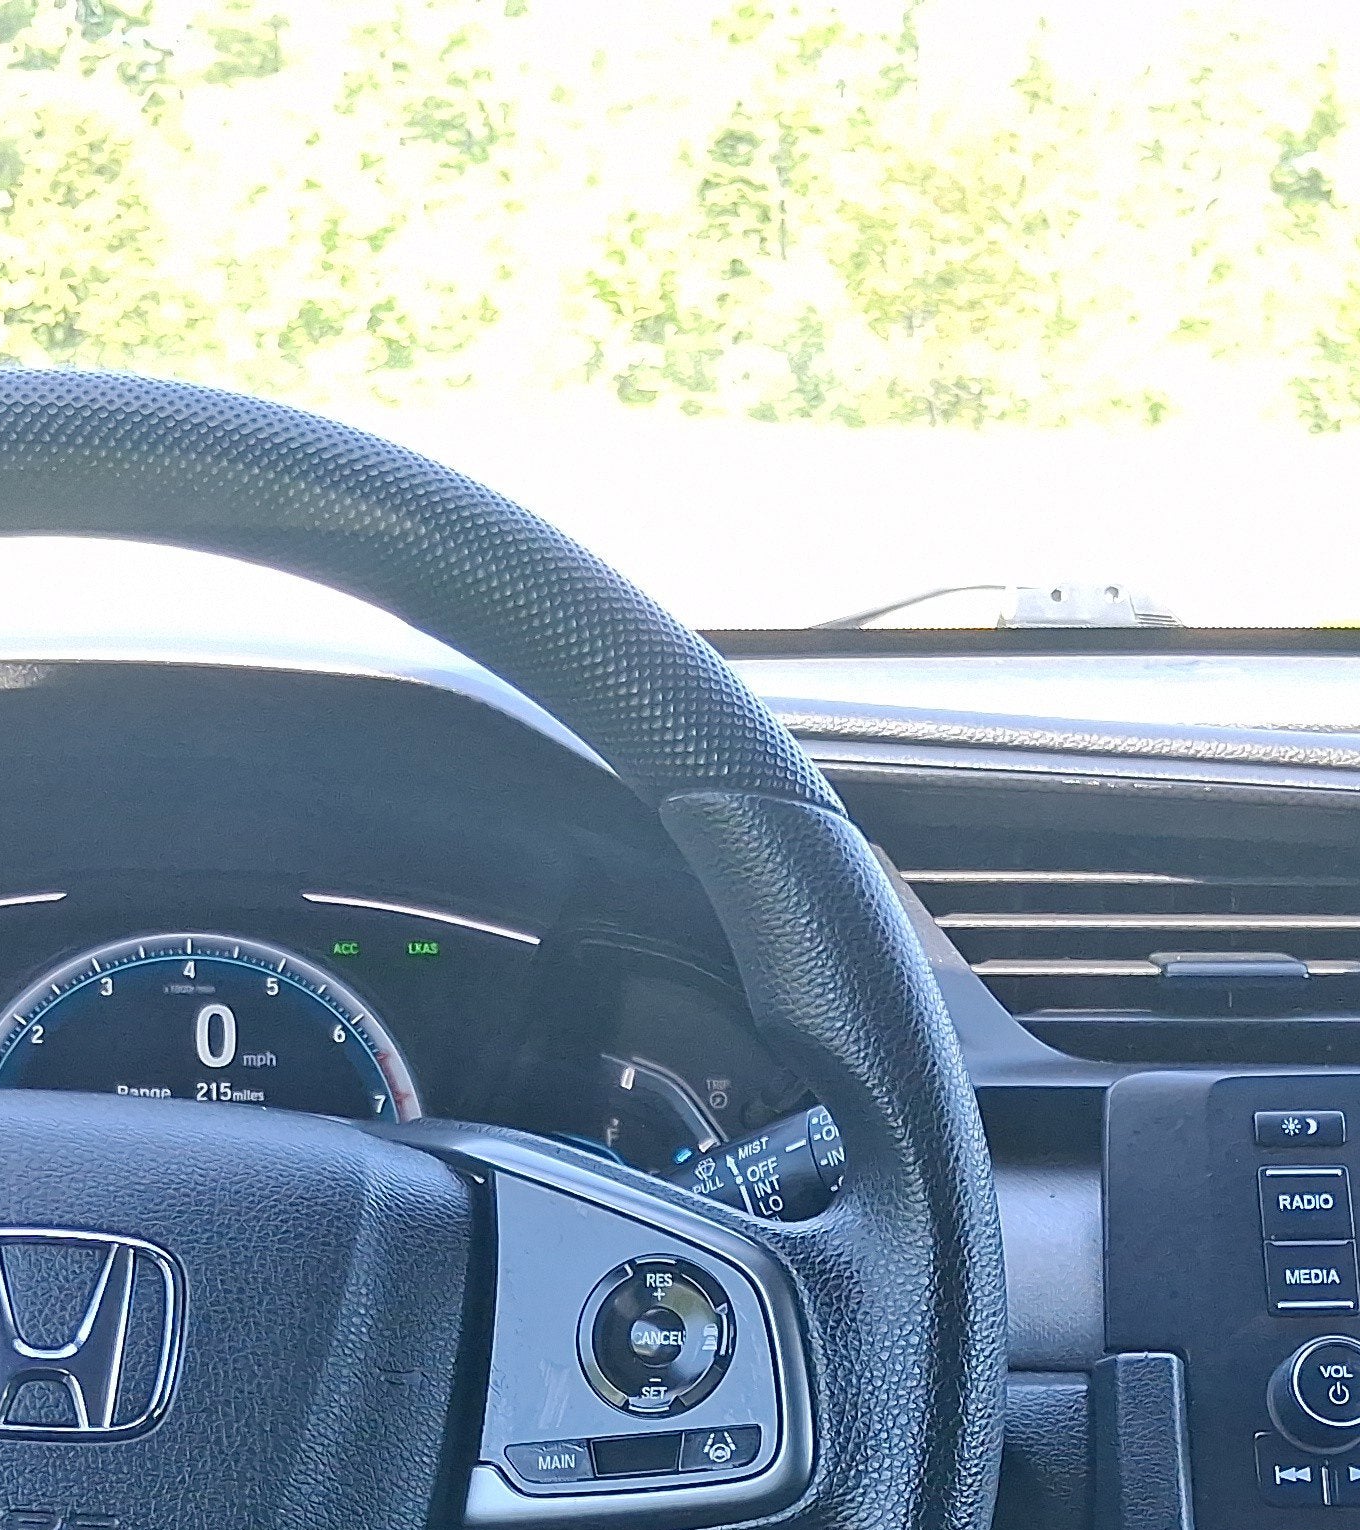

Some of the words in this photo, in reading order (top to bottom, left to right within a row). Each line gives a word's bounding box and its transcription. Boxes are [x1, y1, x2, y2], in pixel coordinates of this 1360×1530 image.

[333, 943, 358, 954] ACC
[183, 961, 195, 979] 4
[100, 977, 113, 996] 3
[266, 978, 279, 996] 5
[31, 1025, 44, 1044] 2
[196, 1003, 237, 1068] 0
[333, 1024, 346, 1043] 6
[242, 1051, 277, 1067] mph
[196, 1082, 232, 1101] 215
[374, 1095, 386, 1113] 7
[738, 1136, 770, 1160] MIST
[746, 1156, 778, 1182] OFF
[693, 1176, 725, 1195] PULL
[753, 1174, 780, 1199] INT
[759, 1194, 784, 1217] LO
[1278, 1192, 1334, 1212] RADIO
[646, 1273, 674, 1288] RES
[1285, 1267, 1341, 1286] MEDIA
[1318, 1363, 1353, 1380] VOL
[641, 1386, 668, 1400] SET
[537, 1453, 576, 1471] MAIN
